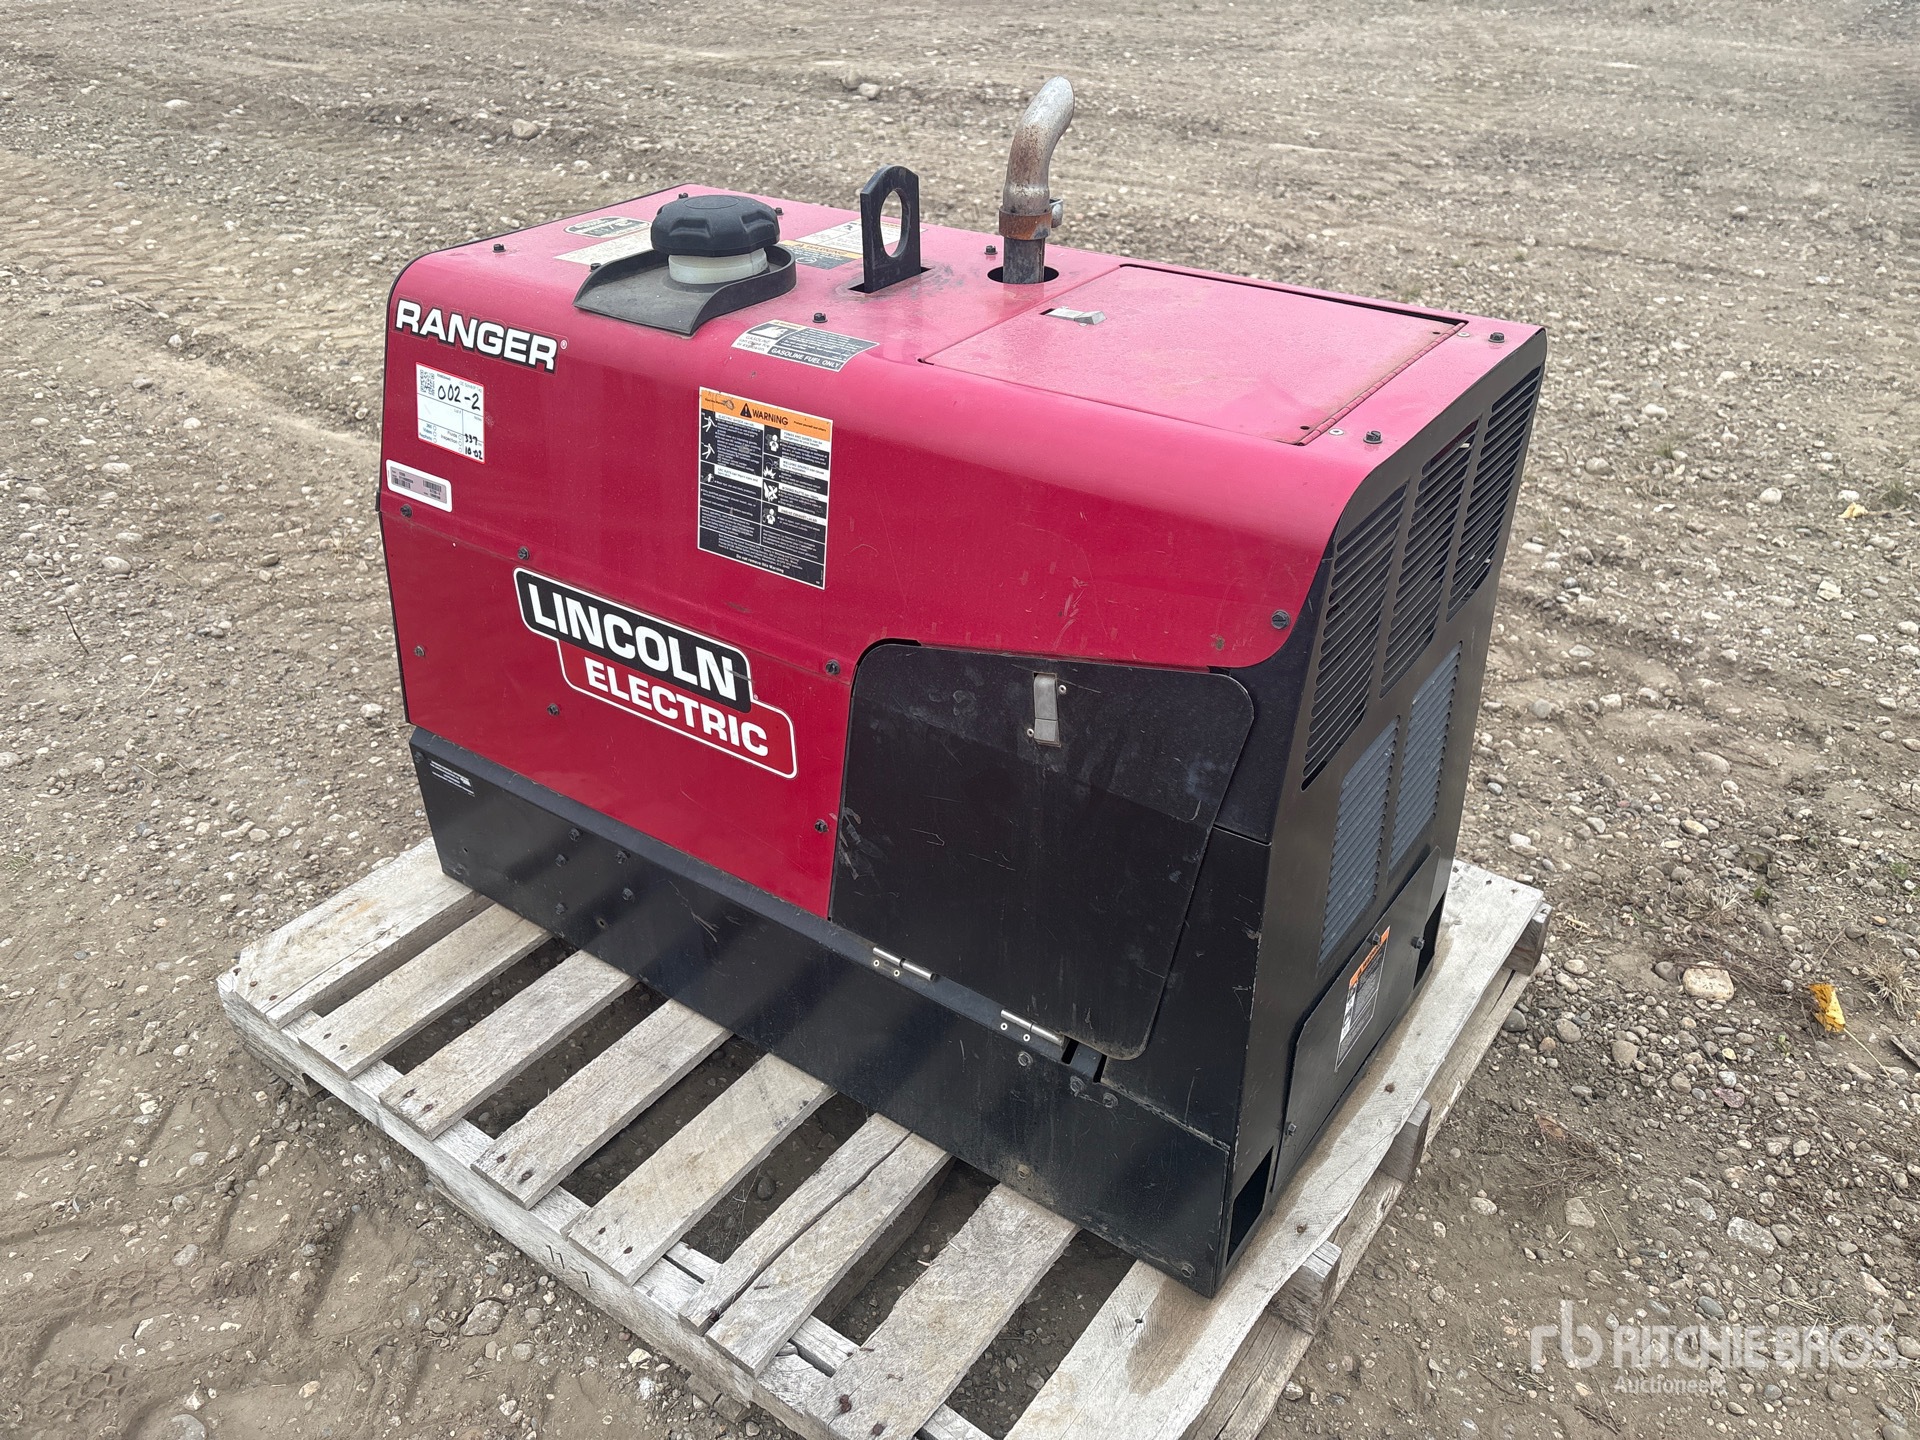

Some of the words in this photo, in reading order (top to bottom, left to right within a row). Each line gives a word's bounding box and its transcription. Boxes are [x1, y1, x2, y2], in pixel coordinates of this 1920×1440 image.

[771, 348, 804, 360] GASOLINE
[804, 356, 820, 364] FUEL
[822, 360, 840, 368] ONLY
[752, 409, 788, 426] WARNING
[528, 583, 736, 701] LINCOLN
[584, 656, 768, 757] ELECTRIC
